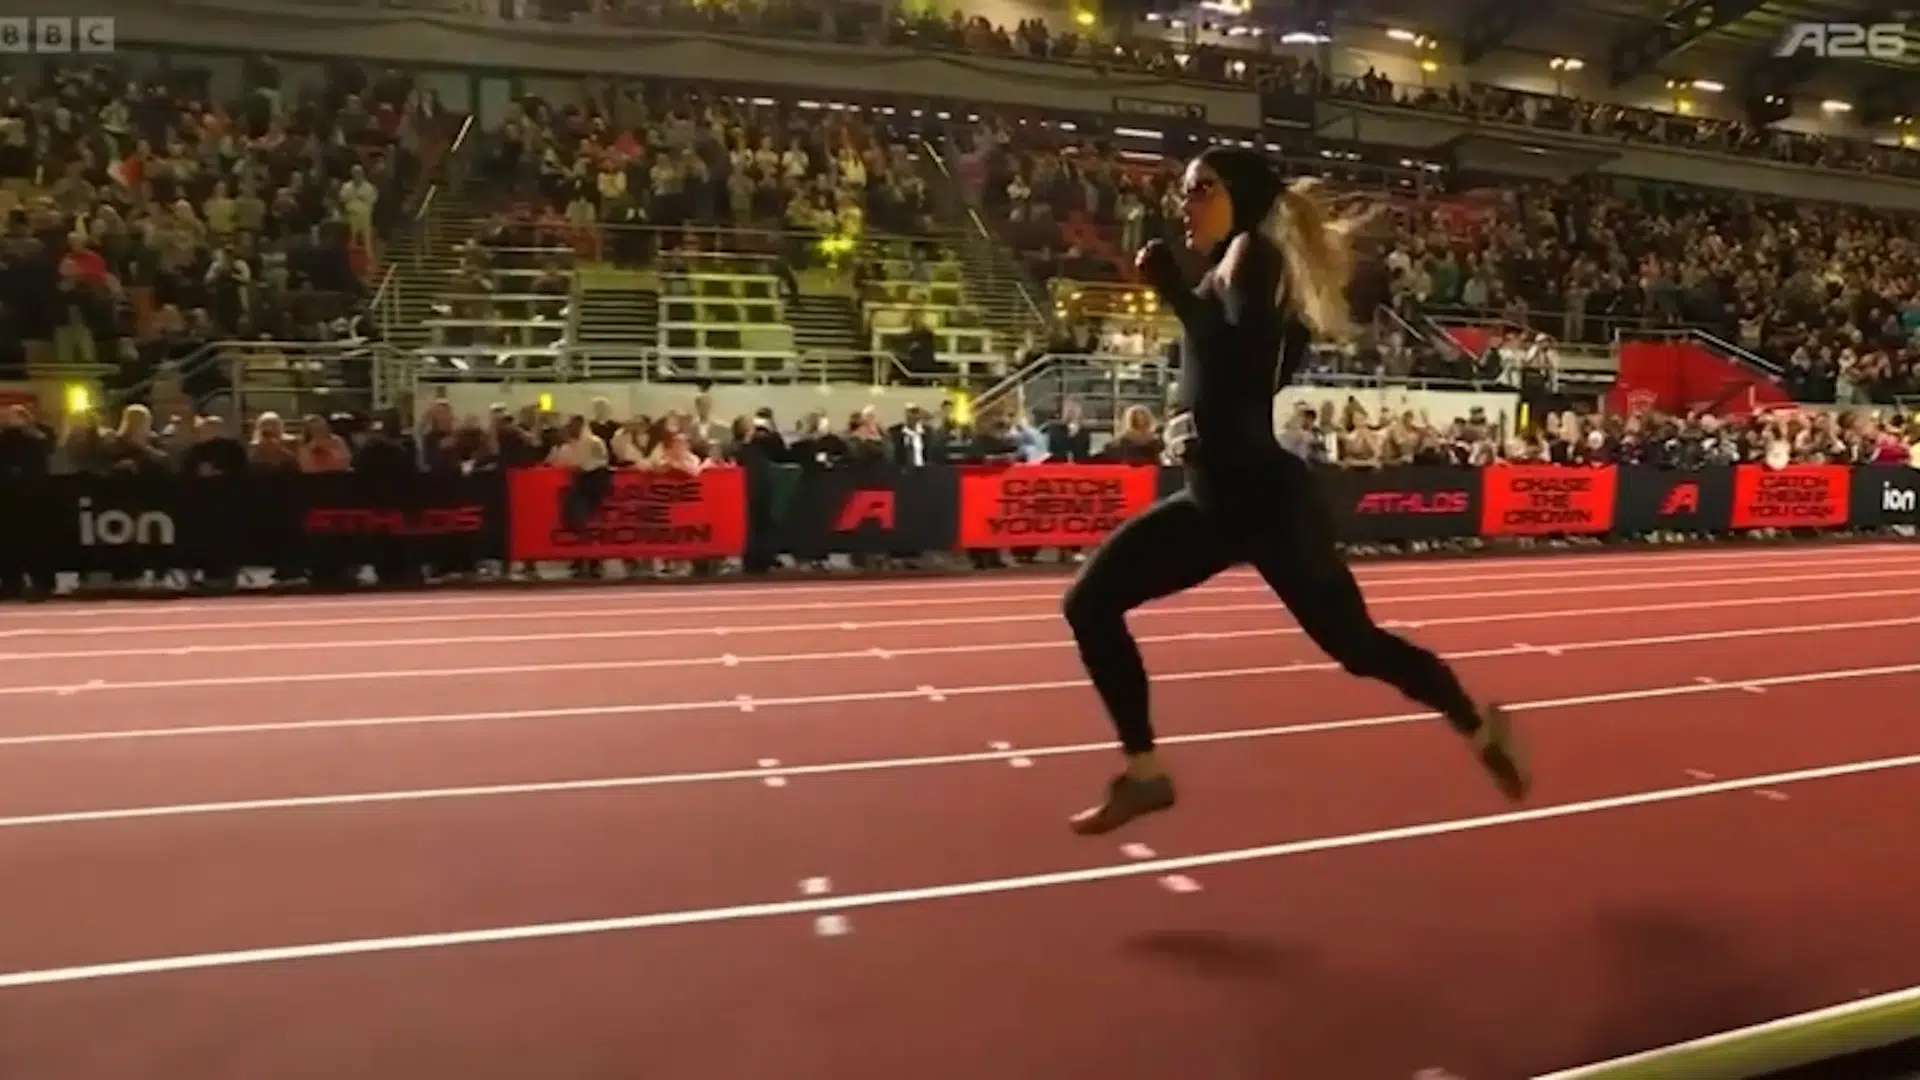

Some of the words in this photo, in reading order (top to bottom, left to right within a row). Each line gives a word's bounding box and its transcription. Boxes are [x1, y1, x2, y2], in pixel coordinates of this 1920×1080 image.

[1002, 478, 1123, 496] CATCH
[1510, 477, 1592, 492] CHASE
[1759, 475, 1828, 489] CATCH
[1354, 491, 1469, 514] ATHLOS
[1531, 494, 1568, 508] THE
[1882, 480, 1916, 512] ion
[996, 497, 1094, 515] THEM
[1748, 505, 1788, 517] YOU
[1793, 504, 1836, 518] CAN
[78, 496, 176, 546] ion
[305, 505, 484, 535] ATHLOS
[986, 517, 1056, 534] YOU
[1503, 510, 1593, 524] CROWN
[551, 524, 712, 546] CROWN
